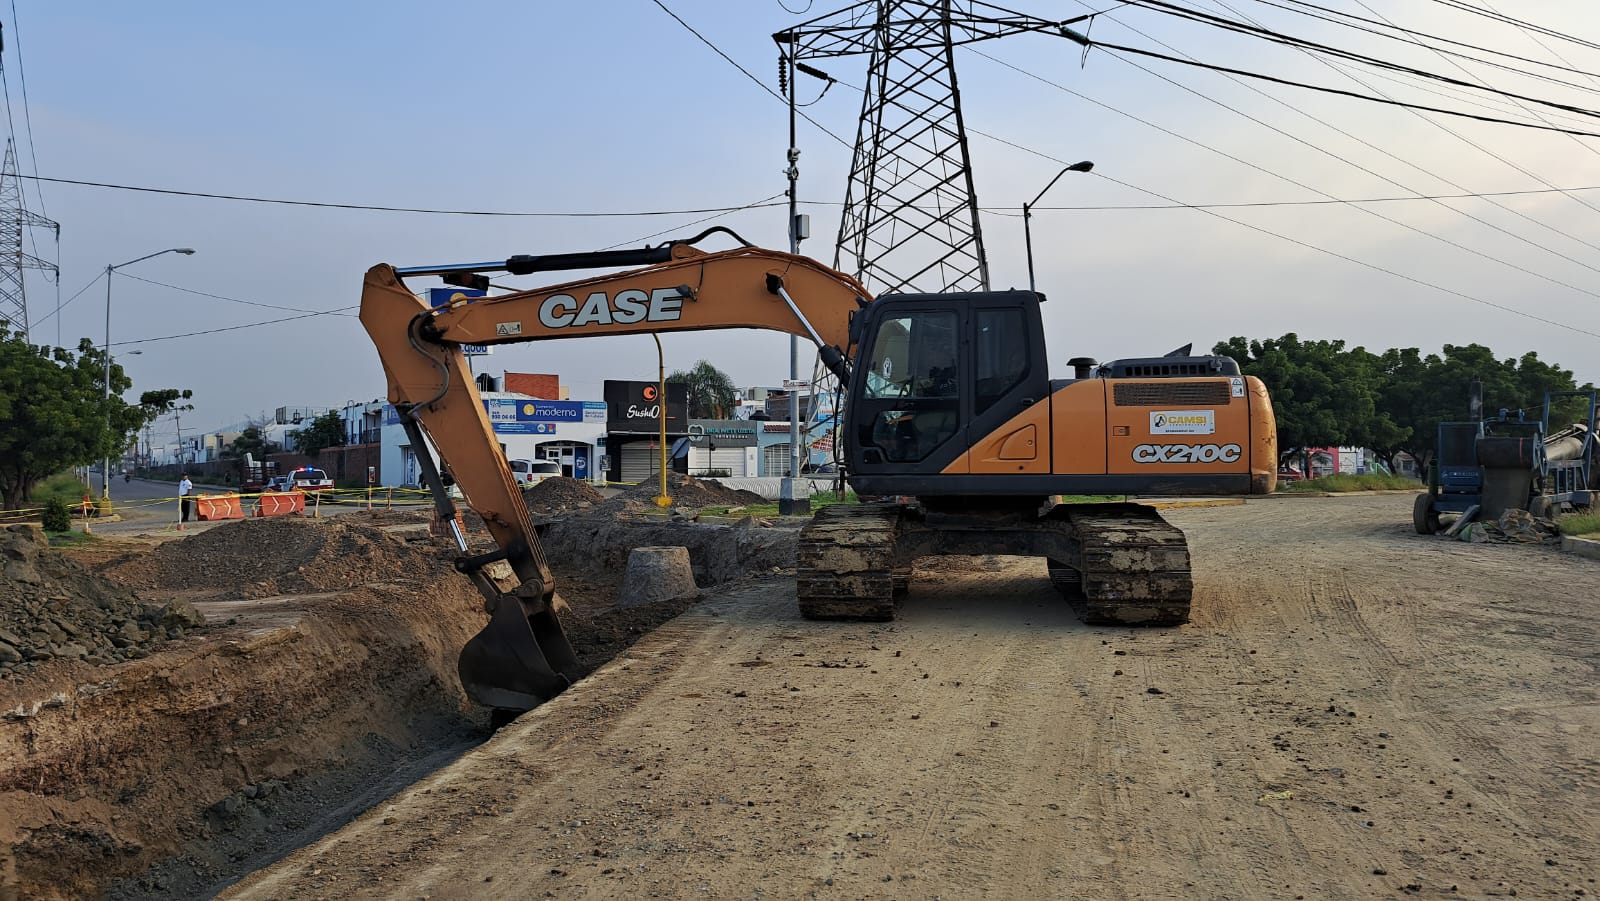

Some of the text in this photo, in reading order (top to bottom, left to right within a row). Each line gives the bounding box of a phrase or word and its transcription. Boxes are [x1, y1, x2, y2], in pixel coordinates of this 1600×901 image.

[538, 287, 683, 328] CASE
[535, 408, 577, 417] moderna
[1168, 416, 1207, 424] CAMSI
[1132, 443, 1241, 463] CX210C
